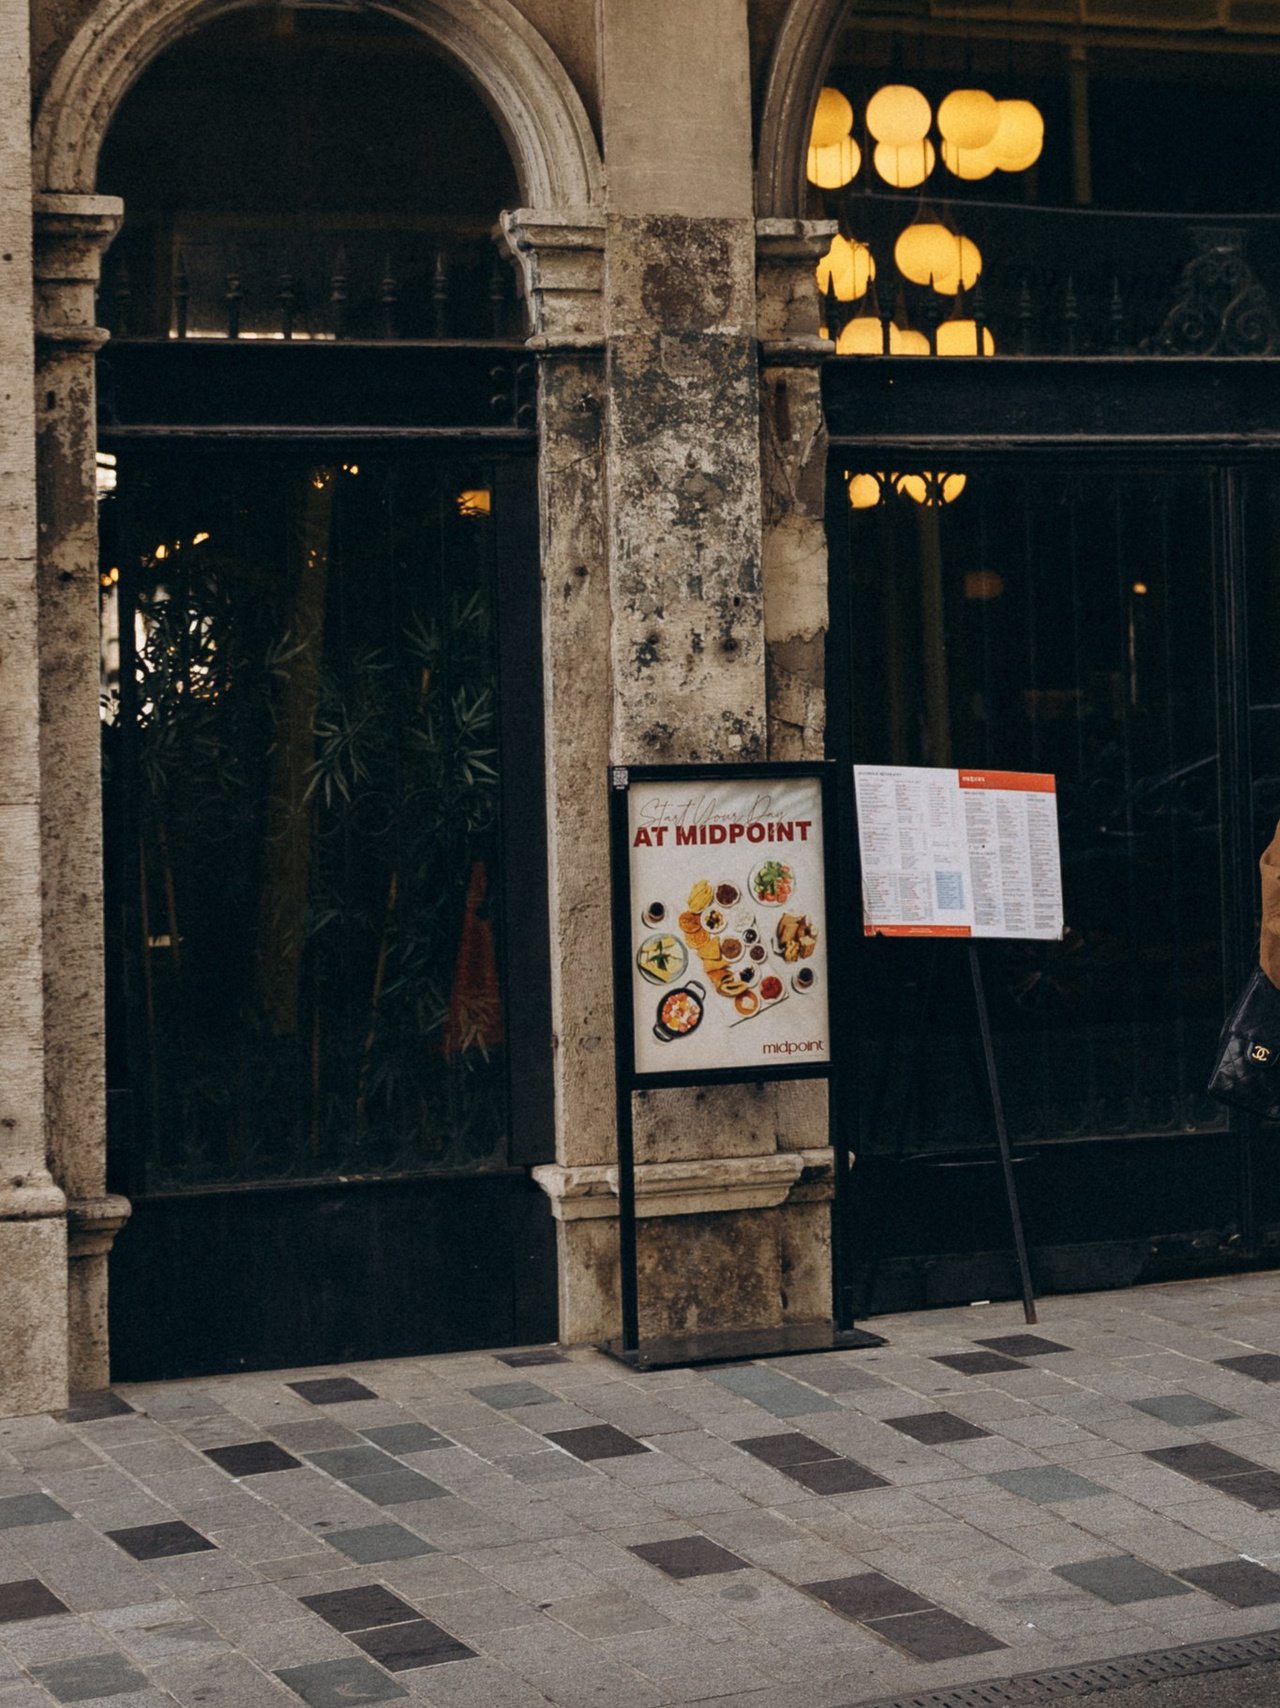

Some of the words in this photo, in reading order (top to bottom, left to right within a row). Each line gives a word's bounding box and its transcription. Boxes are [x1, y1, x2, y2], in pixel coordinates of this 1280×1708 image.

[638, 797, 696, 831] Start
[694, 795, 744, 830] Your
[744, 794, 787, 833] Day
[633, 825, 669, 848] AT
[676, 820, 812, 846] MIDPOINT
[762, 1039, 825, 1056] midpoint
